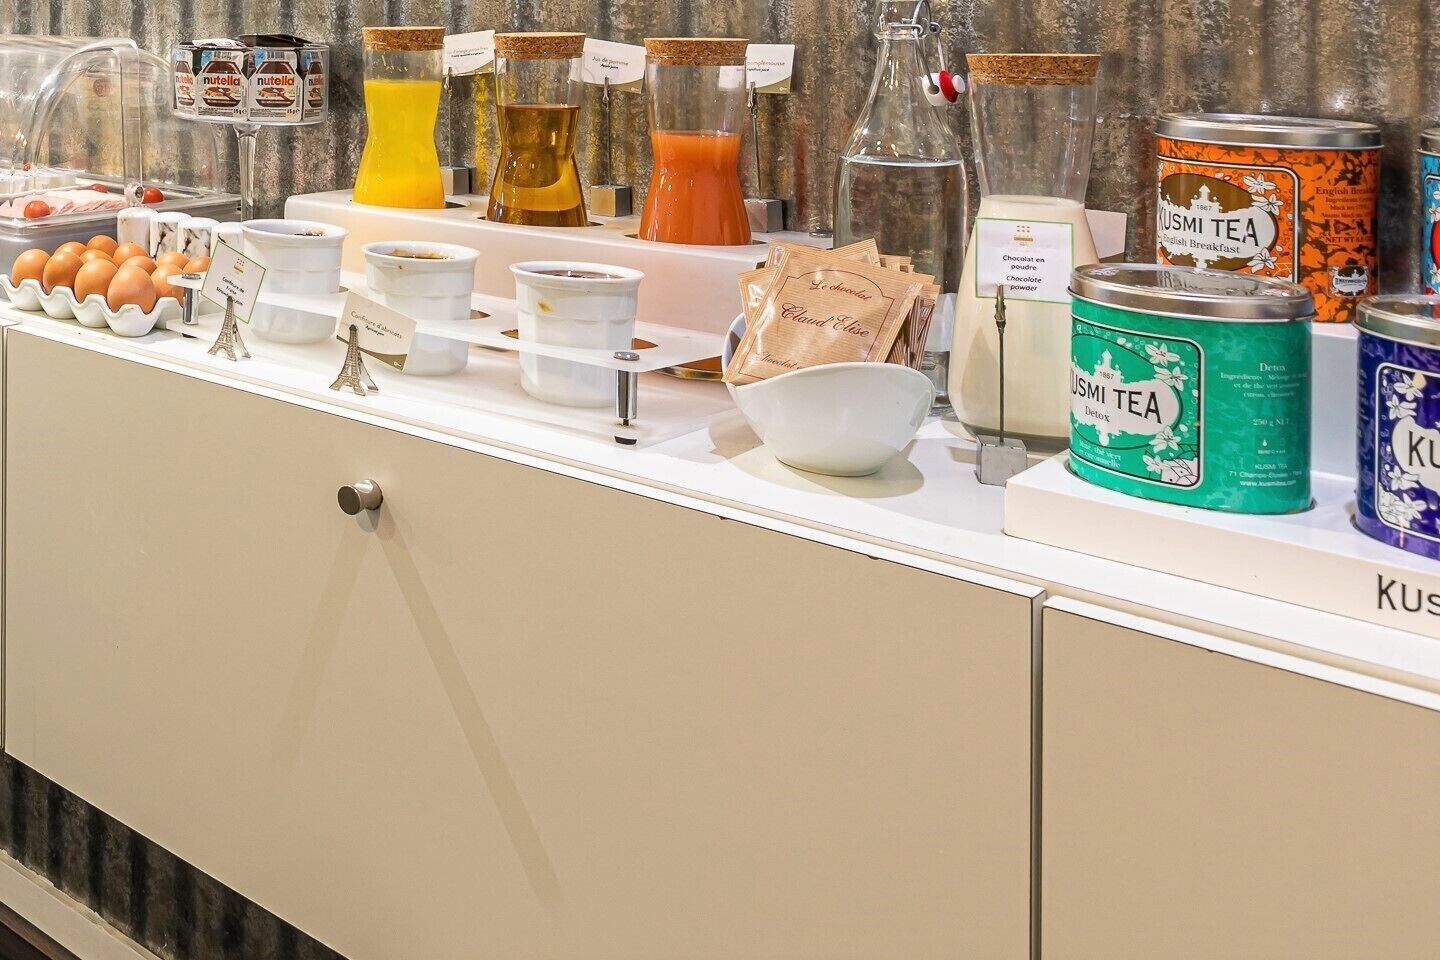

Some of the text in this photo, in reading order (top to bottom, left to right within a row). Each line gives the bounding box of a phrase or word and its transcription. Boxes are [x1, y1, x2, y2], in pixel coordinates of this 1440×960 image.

[203, 75, 241, 86] nutella
[257, 75, 295, 86] nutella
[1196, 204, 1212, 212] 1867
[1159, 203, 1259, 247] KUSMI TEA
[1163, 233, 1241, 254] English Breakfast
[1002, 254, 1034, 263] Chocolat
[1006, 275, 1042, 284] Chocolate
[809, 279, 873, 301] Le chocolat
[1010, 284, 1038, 292] powder
[351, 310, 376, 327] Confiture
[1260, 362, 1286, 372] Detox
[1099, 371, 1115, 380] 1867
[1113, 388, 1162, 424] TEA
[1085, 405, 1110, 422] Detox
[1253, 418, 1267, 426] 250
[1408, 430, 1440, 468] KU
